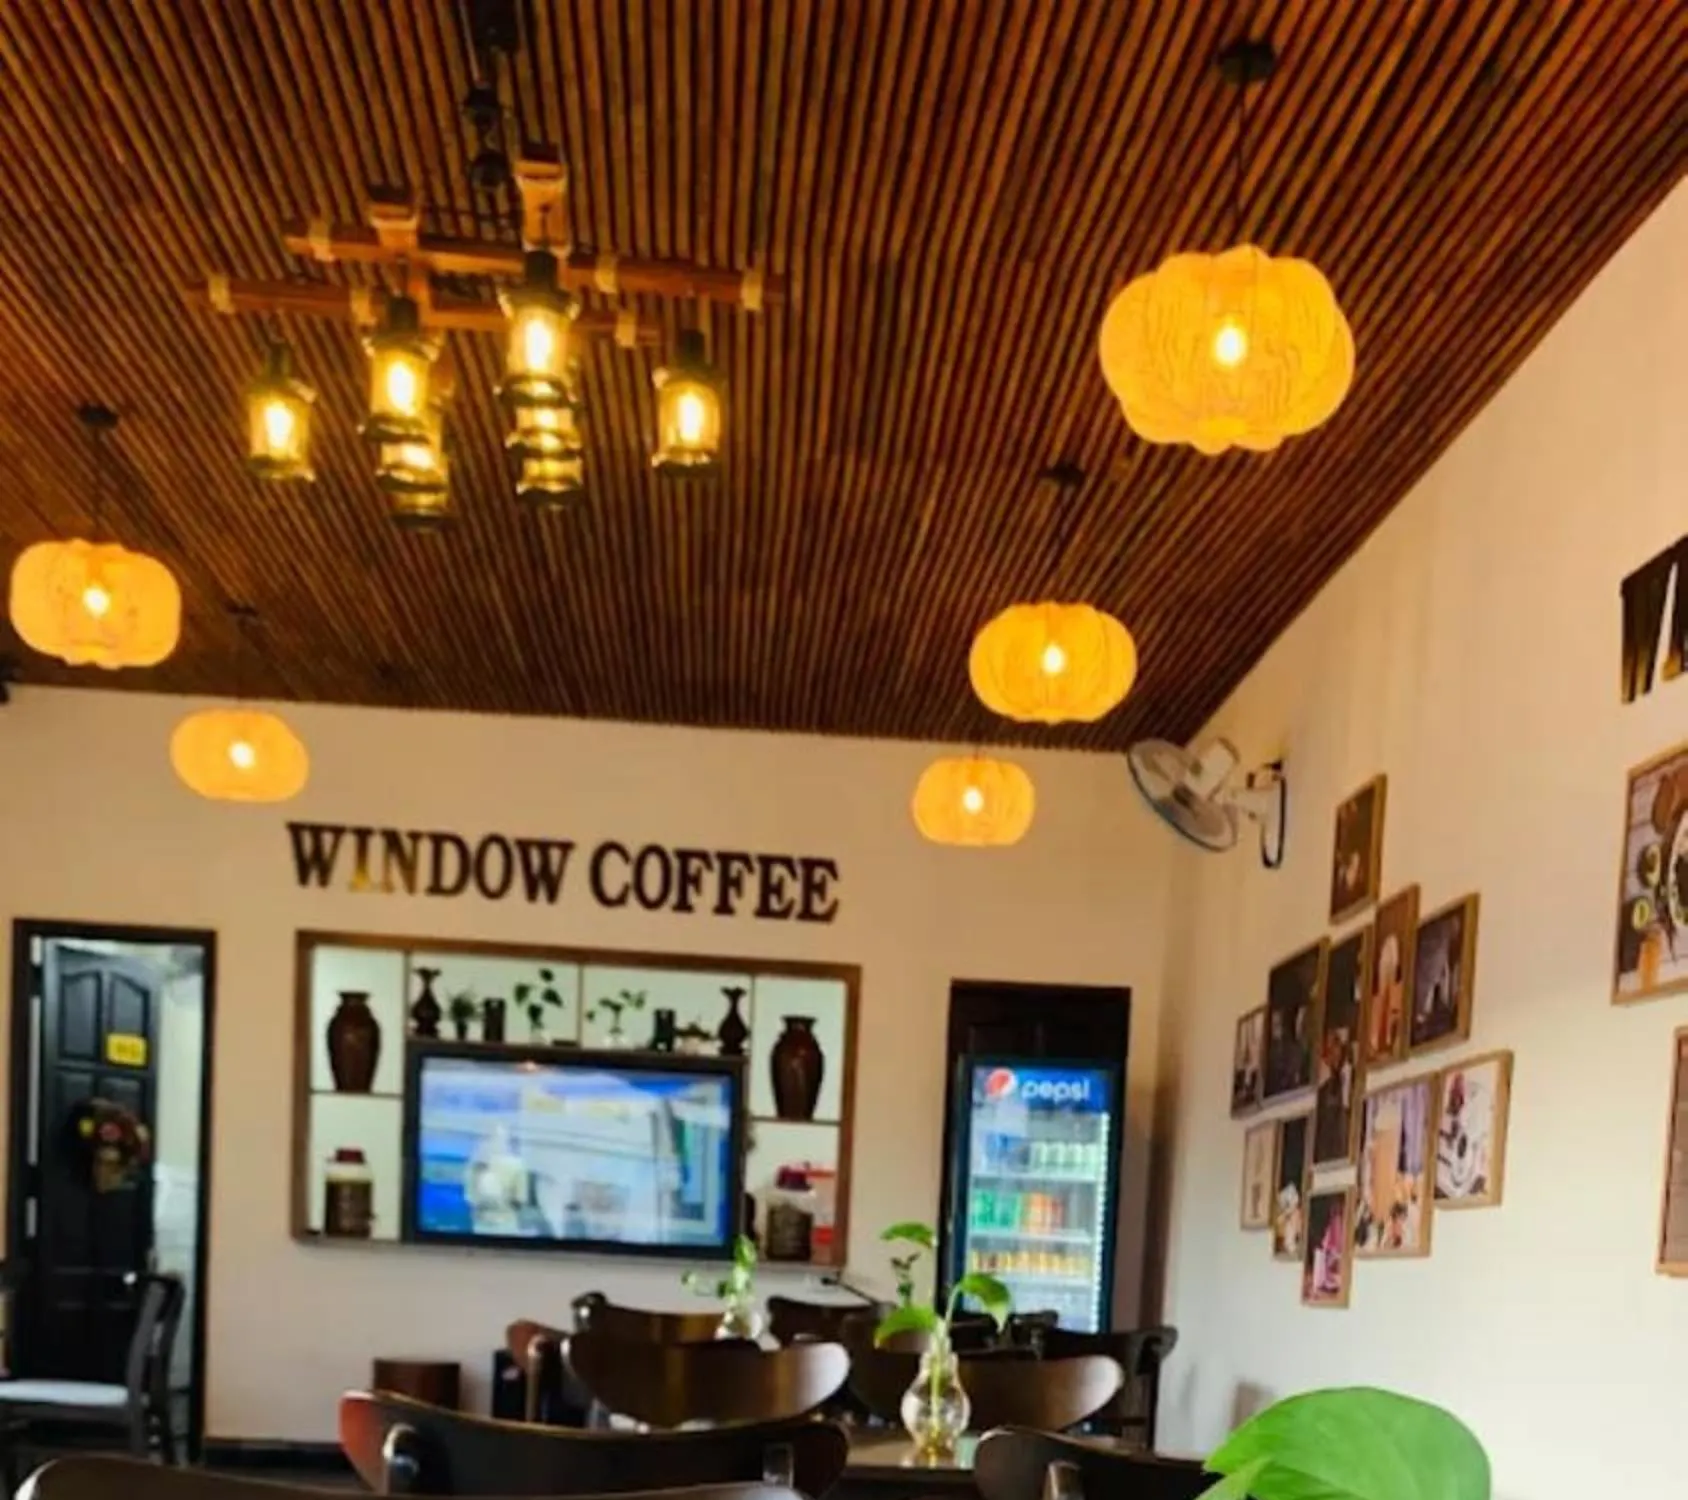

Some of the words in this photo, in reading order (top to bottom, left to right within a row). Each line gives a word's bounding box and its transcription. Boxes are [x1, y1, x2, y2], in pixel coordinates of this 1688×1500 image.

[286, 821, 576, 904] WINDOW
[589, 841, 840, 923] COFFEE
[1021, 1079, 1090, 1103] pepsi
